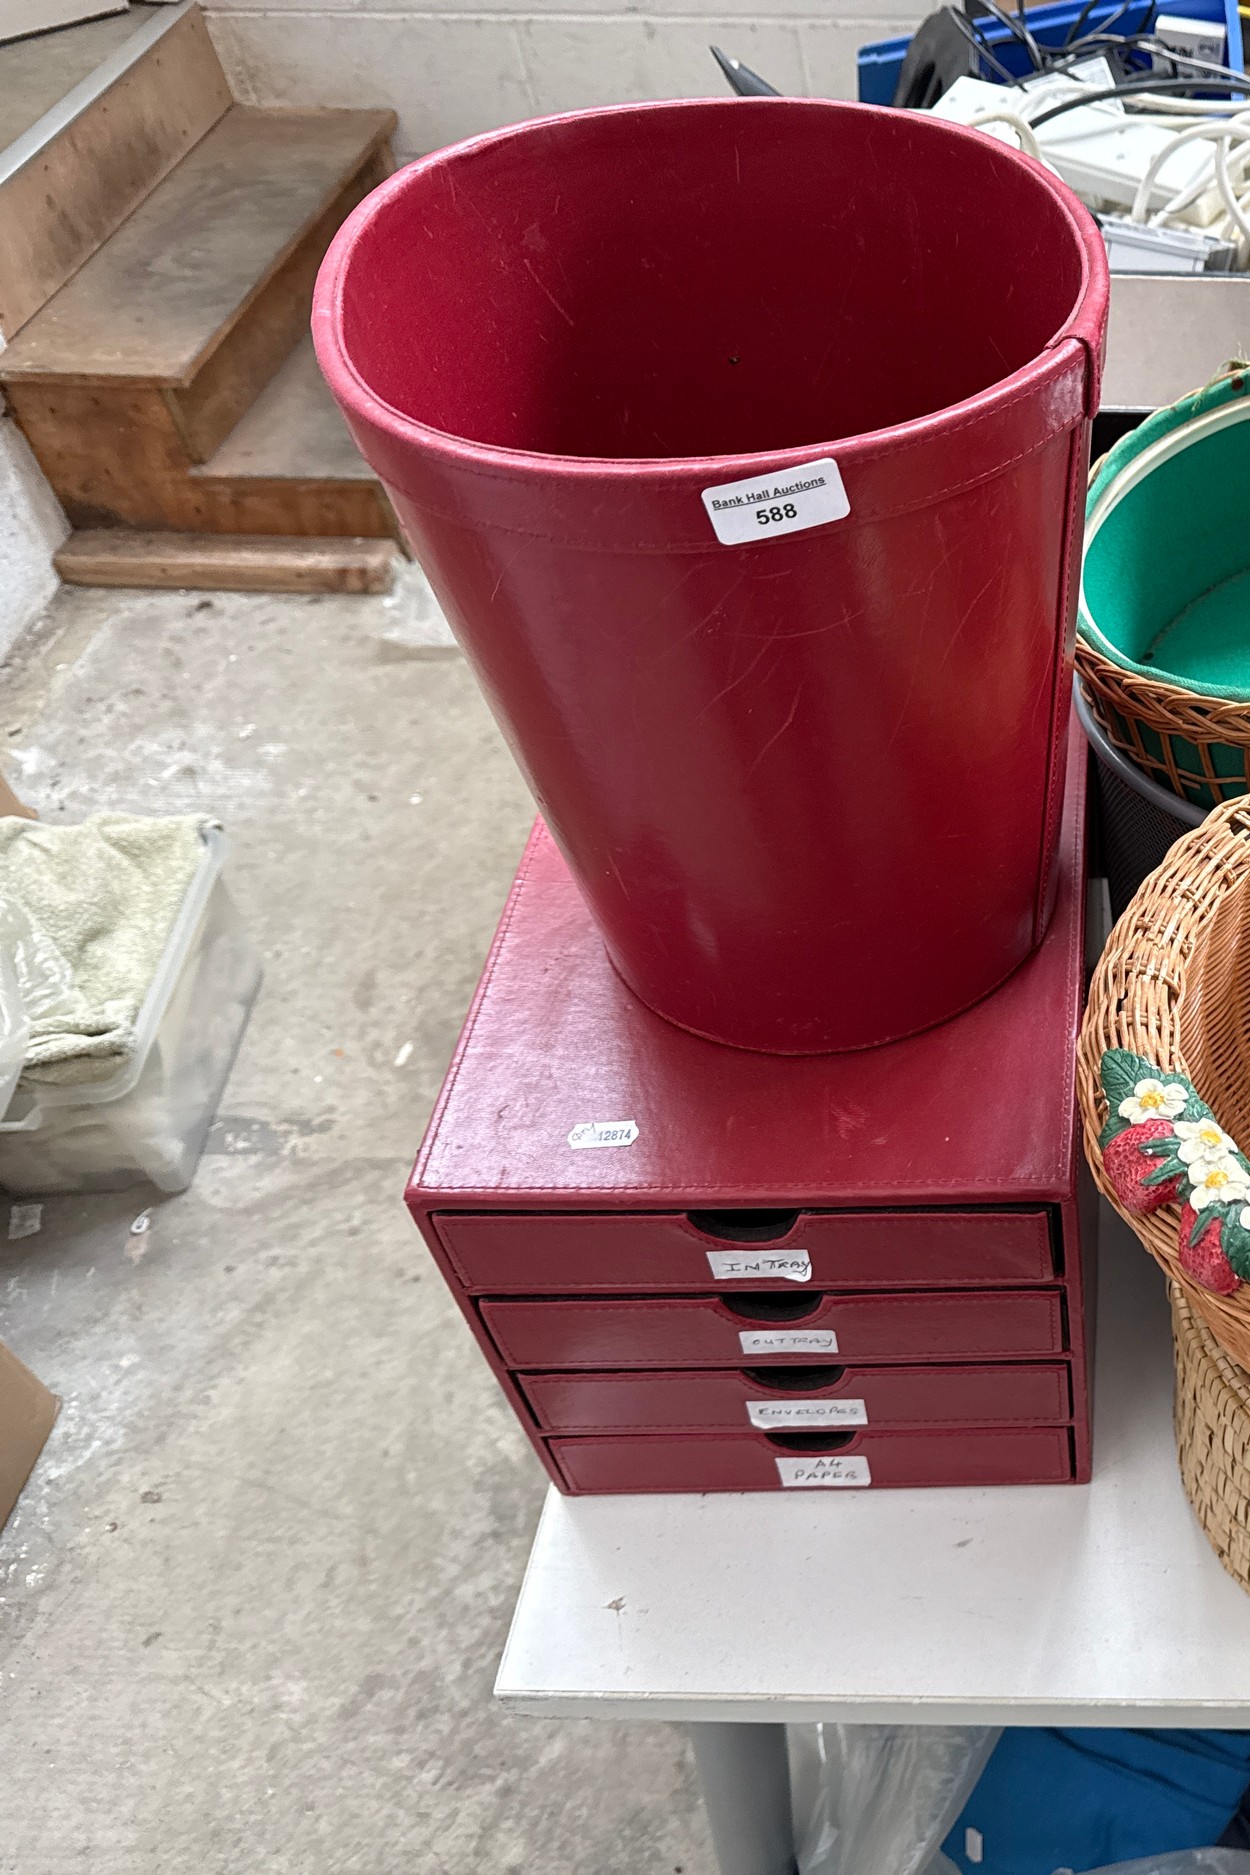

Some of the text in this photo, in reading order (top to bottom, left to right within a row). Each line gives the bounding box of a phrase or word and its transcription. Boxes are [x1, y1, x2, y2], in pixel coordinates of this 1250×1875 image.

[711, 476, 826, 509] Bank Hall Auctions
[756, 502, 798, 526] 588
[598, 1128, 632, 1141] 12874
[721, 1262, 760, 1272] IN
[752, 1337, 833, 1348] OUT TRAY
[758, 1406, 859, 1416] ENVELOPES
[815, 1458, 843, 1470] A4
[794, 1469, 858, 1481] PAPER
